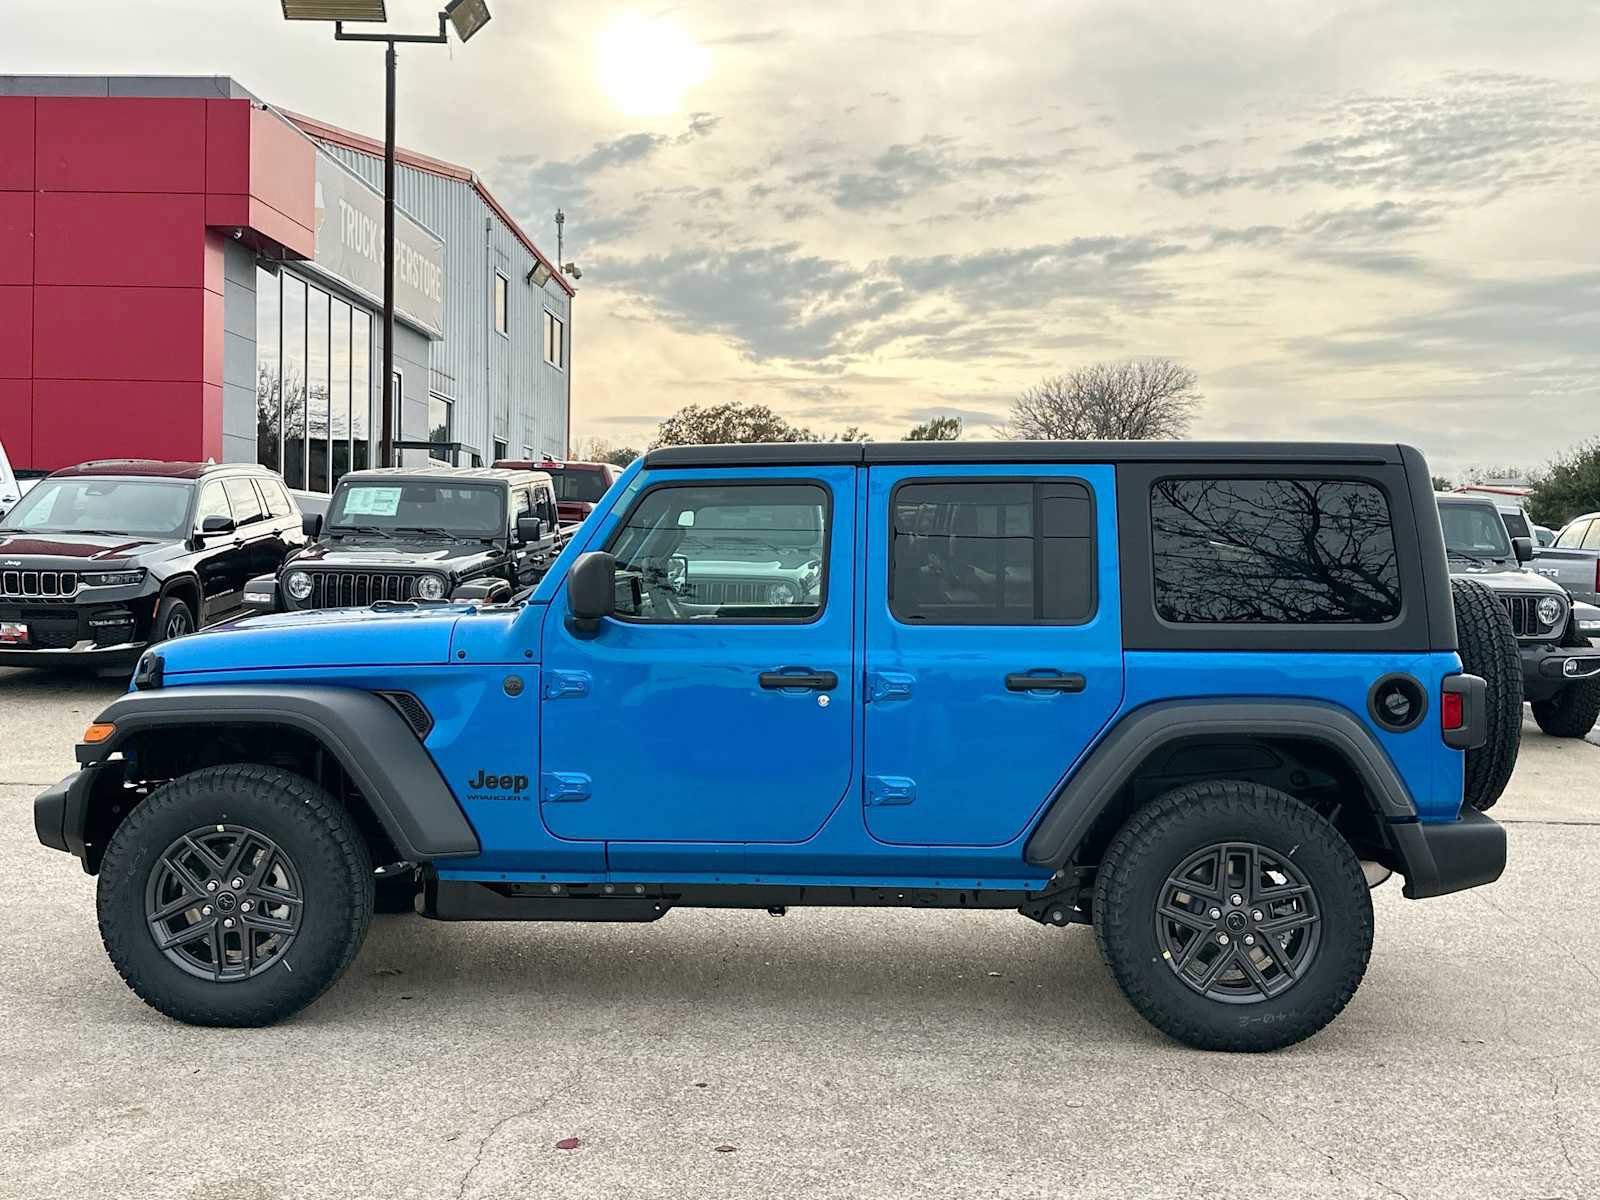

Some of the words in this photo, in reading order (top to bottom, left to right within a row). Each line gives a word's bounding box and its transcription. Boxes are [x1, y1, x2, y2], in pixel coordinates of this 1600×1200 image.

[338, 197, 378, 265] TRUCK
[380, 226, 442, 304] PERSTORE
[468, 768, 529, 793] Jeep
